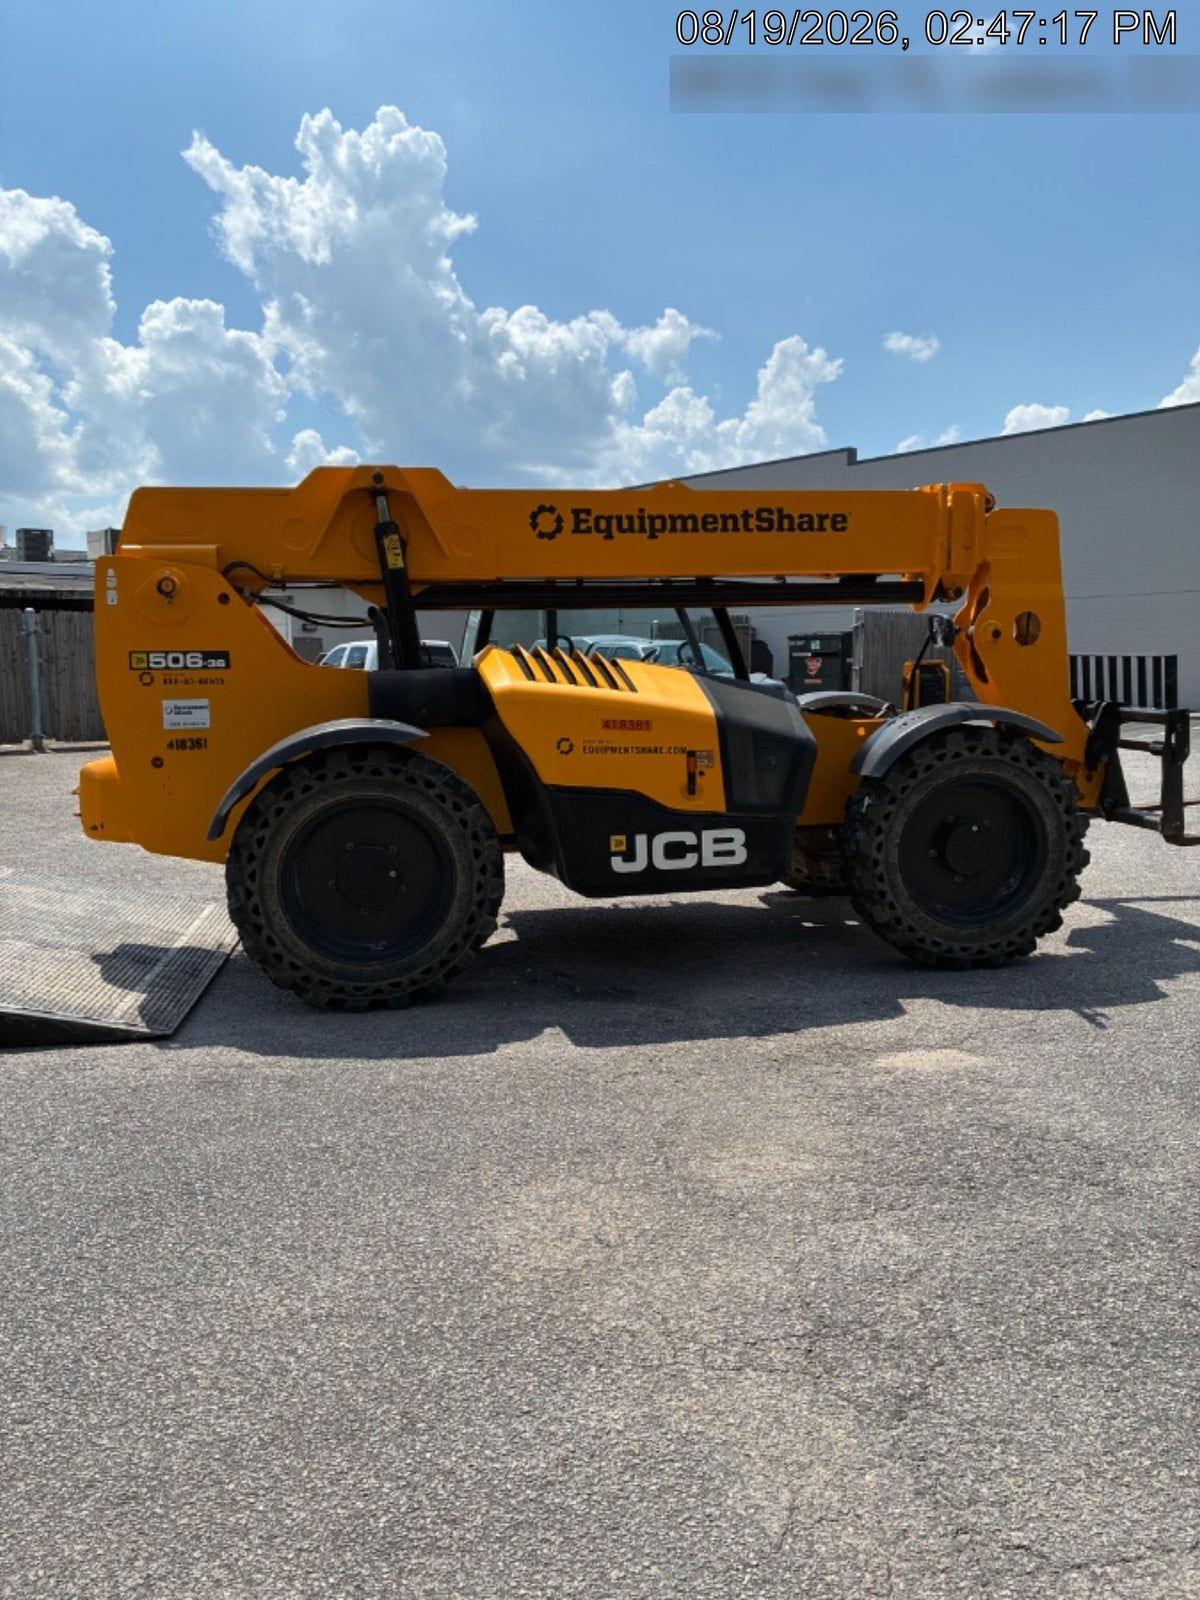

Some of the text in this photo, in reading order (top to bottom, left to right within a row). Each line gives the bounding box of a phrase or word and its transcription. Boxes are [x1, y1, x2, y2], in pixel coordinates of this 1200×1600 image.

[570, 507, 848, 540] EquipmentShare
[582, 745, 688, 755] EQUIPMENTSHARE.COM
[610, 828, 748, 873] JCB
